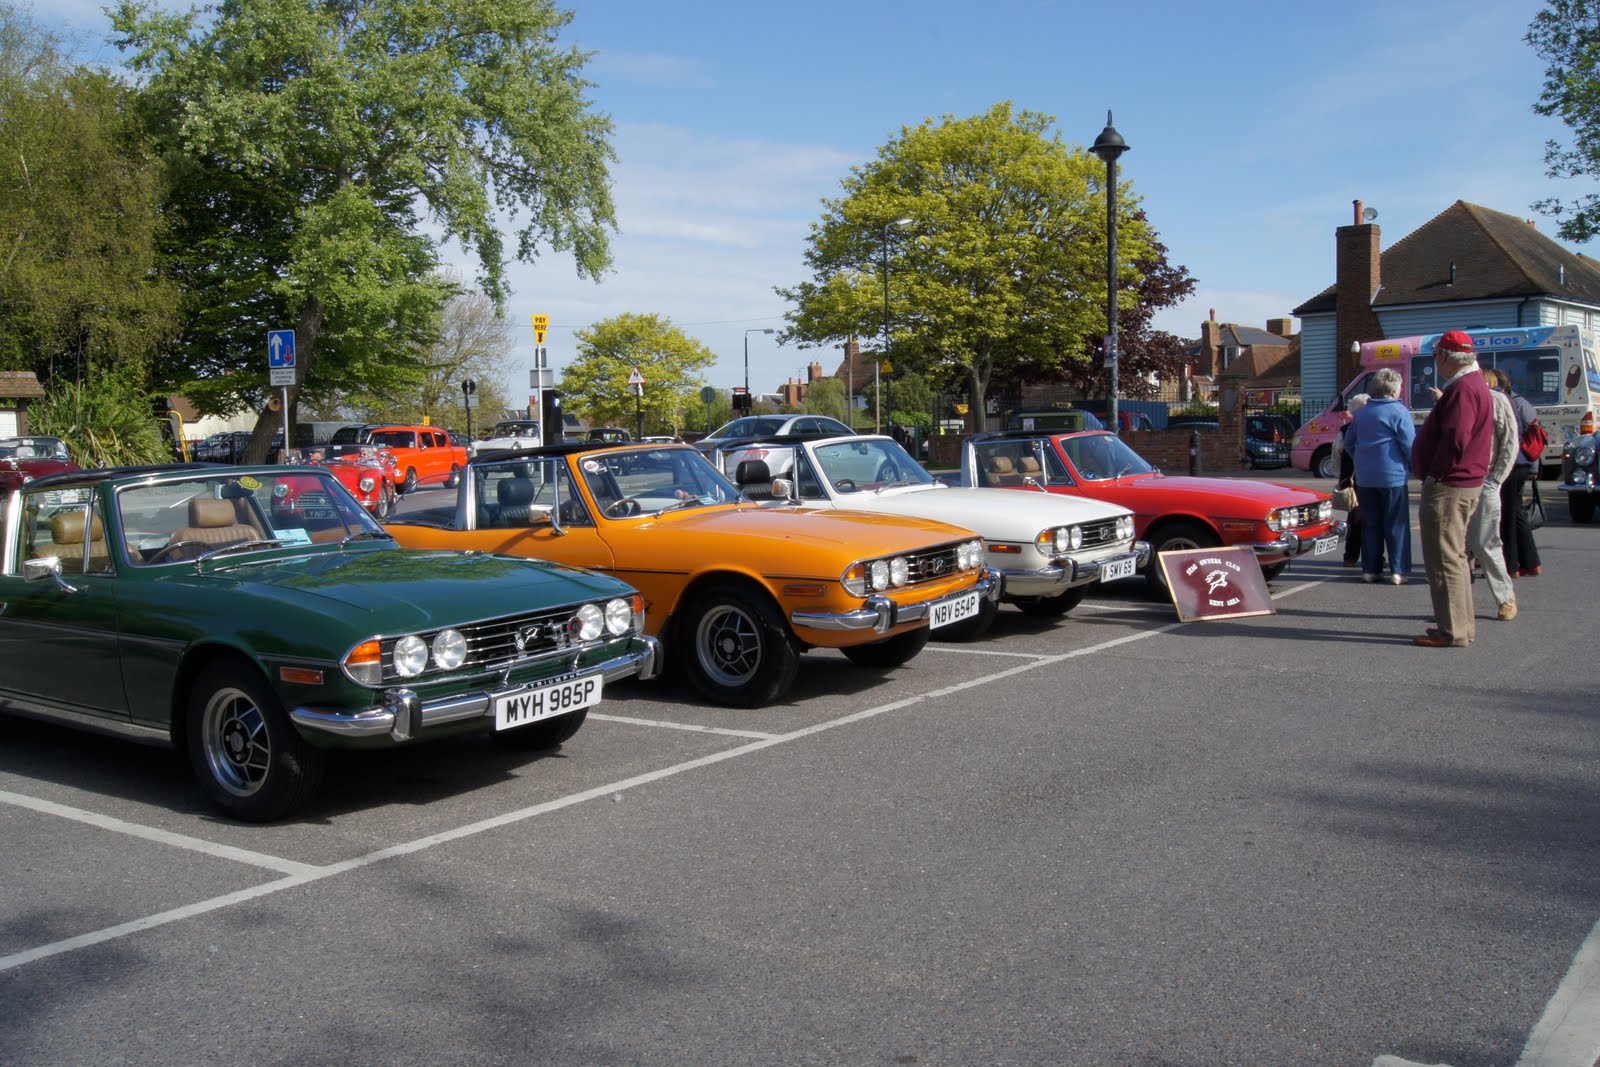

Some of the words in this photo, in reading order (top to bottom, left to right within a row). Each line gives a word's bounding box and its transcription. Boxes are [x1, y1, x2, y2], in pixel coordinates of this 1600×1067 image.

[1490, 336, 1519, 346] Ices
[1124, 560, 1132, 575] 69
[1199, 558, 1222, 566] OWNERS
[1225, 561, 1241, 572] CLUB
[954, 596, 976, 619] 654P
[530, 674, 576, 688] TRIUMPH
[506, 692, 544, 723] MYH
[549, 680, 595, 712] 985P
